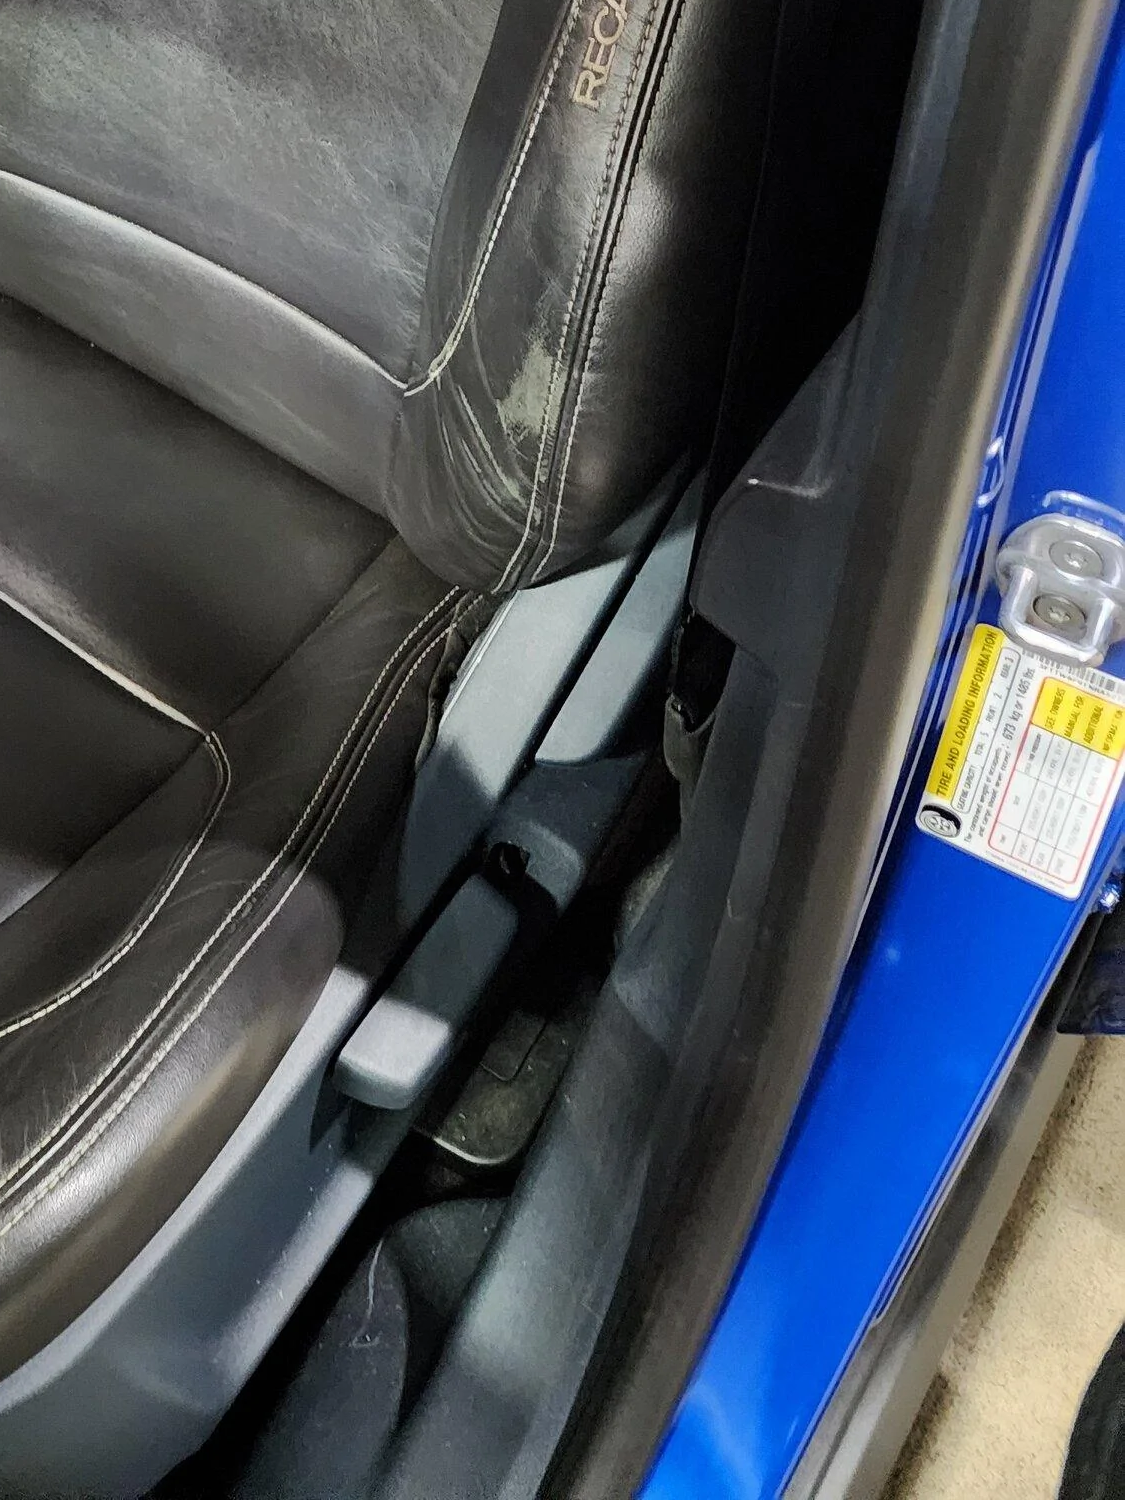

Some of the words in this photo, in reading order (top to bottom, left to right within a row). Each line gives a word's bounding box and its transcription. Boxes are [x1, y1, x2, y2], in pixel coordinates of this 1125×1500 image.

[935, 771, 951, 796] TIRE
[943, 746, 959, 769] AND
[952, 698, 975, 744] LOADING
[967, 629, 998, 698] INFORMATION
[979, 730, 989, 738] 5
[992, 691, 1003, 699] 2
[1008, 709, 1023, 722] kg
[1014, 700, 1024, 710] or
[1062, 709, 1080, 738] MANUAL
[1072, 694, 1085, 709] FOR
[1001, 722, 1017, 741] 673
[1043, 716, 1055, 729] SEE
[1082, 704, 1104, 744] ADDITIONAL
